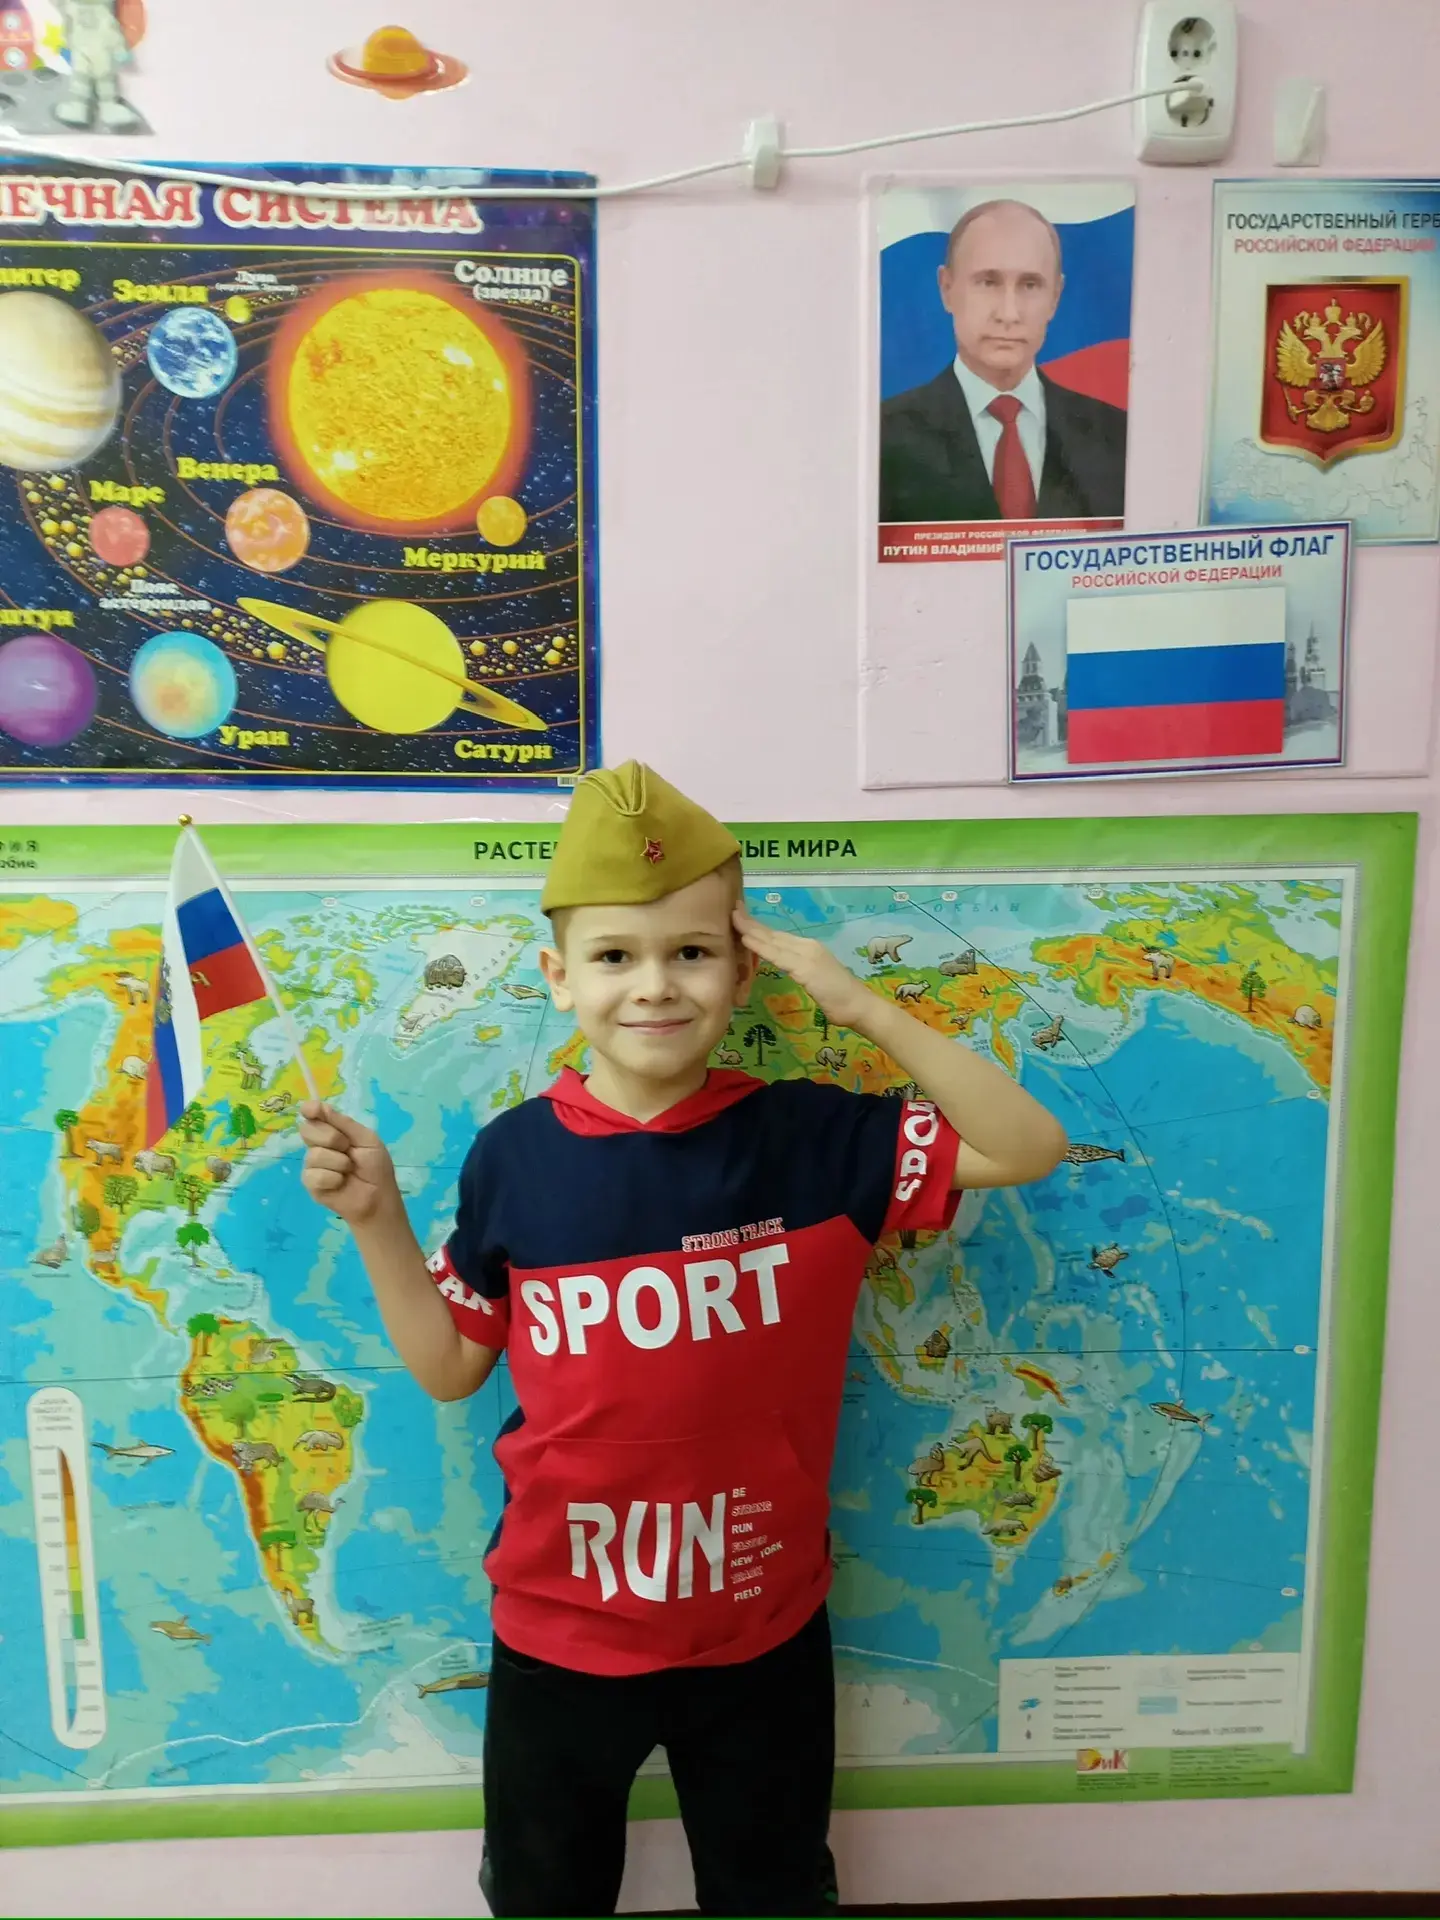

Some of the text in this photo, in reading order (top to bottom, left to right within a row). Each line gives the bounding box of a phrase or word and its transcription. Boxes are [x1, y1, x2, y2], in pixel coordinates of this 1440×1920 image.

[0, 180, 482, 232] ЕЧНАЯ СИСТЕМА
[1227, 209, 1440, 231] ГОСУДАРСТВЕННЫЙ ГЕРБ
[1234, 234, 1436, 254] РОССИЙСКОЙ ФЕДЕРАЦИИ
[454, 260, 569, 288] Солнце
[113, 278, 209, 303] Земля
[176, 456, 280, 487] Венера
[89, 480, 166, 508] Марс
[914, 531, 966, 541] ПРЕЗИДЕНТ
[403, 547, 546, 573] Меркурий
[883, 543, 1004, 556] ПУТИН ВЛАДИМИР
[1024, 534, 1335, 571] ГОСУДАРСТВЕННЫЙ ФЛАГ
[1071, 565, 1282, 589] РОССИЙСКОЙ ФЕДЕРАЦИИ
[218, 725, 290, 750] Уран
[454, 739, 553, 763] Сатурн
[474, 841, 558, 860] РАСТЕ
[787, 839, 857, 857] МИРА
[681, 1217, 785, 1252] STRONG TRACK
[520, 1243, 790, 1356] SPORT
[732, 1487, 747, 1498] BE
[731, 1522, 753, 1534] RUN
[566, 1492, 726, 1602] RUN
[730, 1554, 754, 1568] NEW
[733, 1586, 762, 1602] FIELD
